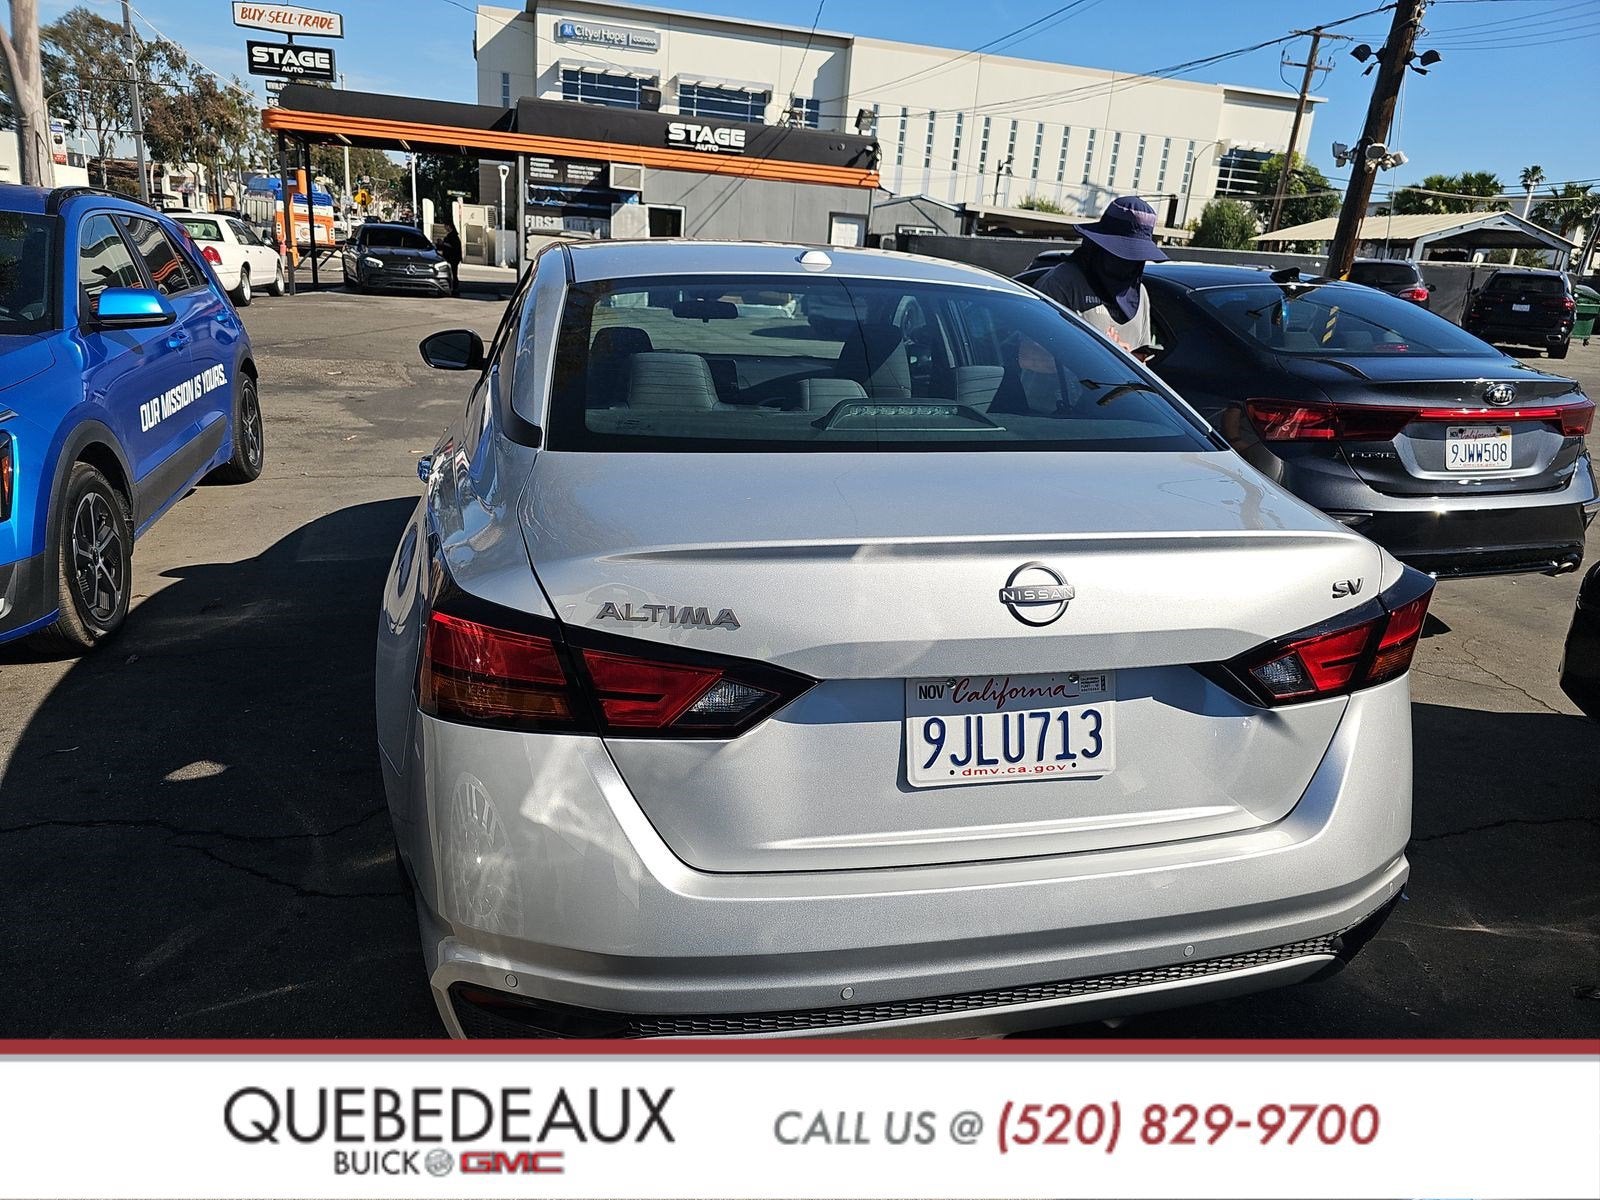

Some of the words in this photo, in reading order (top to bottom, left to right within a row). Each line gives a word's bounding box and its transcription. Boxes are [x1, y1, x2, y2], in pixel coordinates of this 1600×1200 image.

[240, 7, 265, 21] BUY
[267, 11, 294, 25] SELL
[297, 14, 335, 29] TRADE
[574, 24, 594, 39] City
[601, 28, 626, 41] Hope
[252, 46, 330, 69] STAGE
[281, 65, 304, 74] AUTO
[668, 122, 746, 147] STAGE
[695, 143, 719, 152] AUTO
[140, 397, 161, 433] OUR
[160, 378, 195, 420] MISSION
[194, 374, 202, 400] IS
[201, 363, 228, 394] YOURS.
[1451, 442, 1508, 463] 9JWW508
[1002, 586, 1074, 601] NISSAN
[1332, 577, 1364, 599] SV
[596, 602, 741, 627] ALTIMA
[918, 684, 945, 700] NOV
[952, 676, 1079, 709] California
[923, 708, 1103, 769] 9JLU713
[962, 763, 1067, 777] dmv.ca.gov
